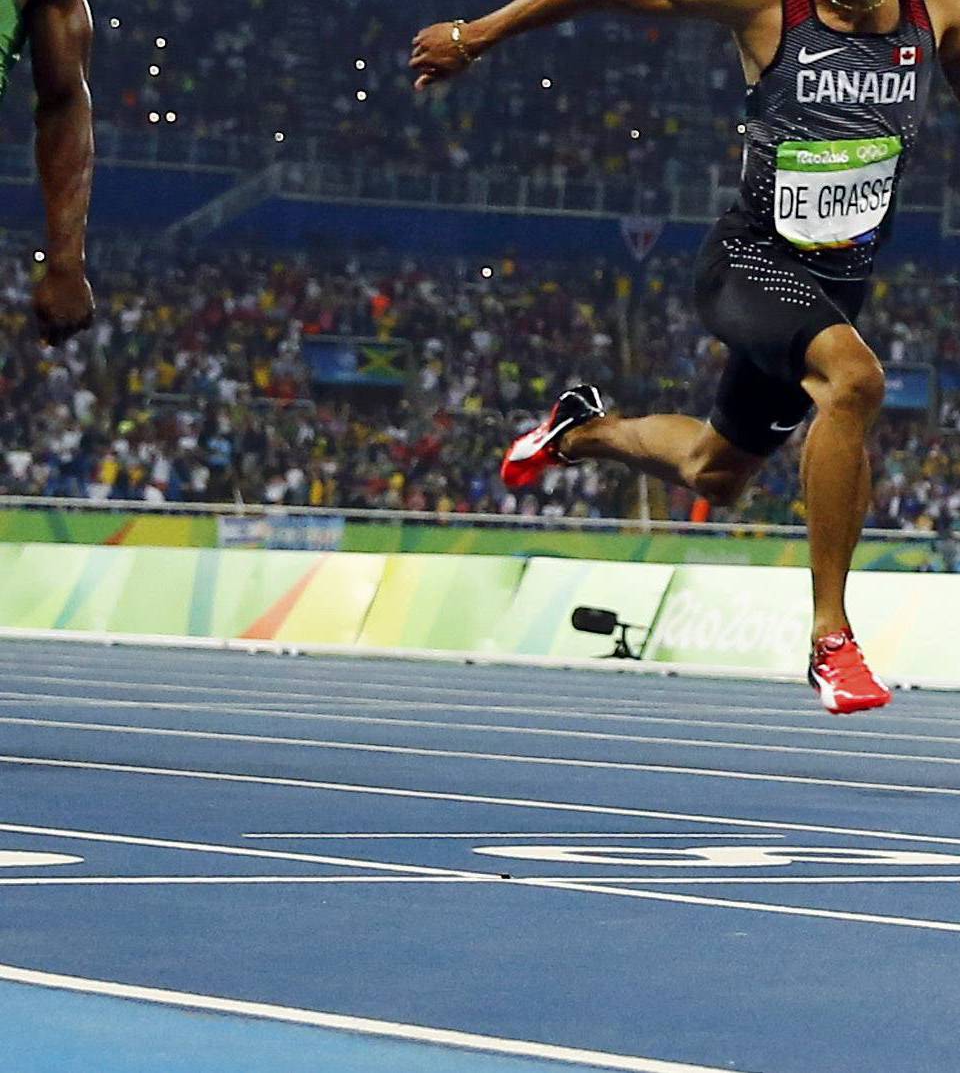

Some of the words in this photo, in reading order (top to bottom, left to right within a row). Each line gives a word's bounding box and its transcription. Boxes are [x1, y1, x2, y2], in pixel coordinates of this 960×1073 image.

[796, 70, 916, 104] CANADA
[779, 186, 808, 220] DE
[818, 176, 893, 219] GRASSE
